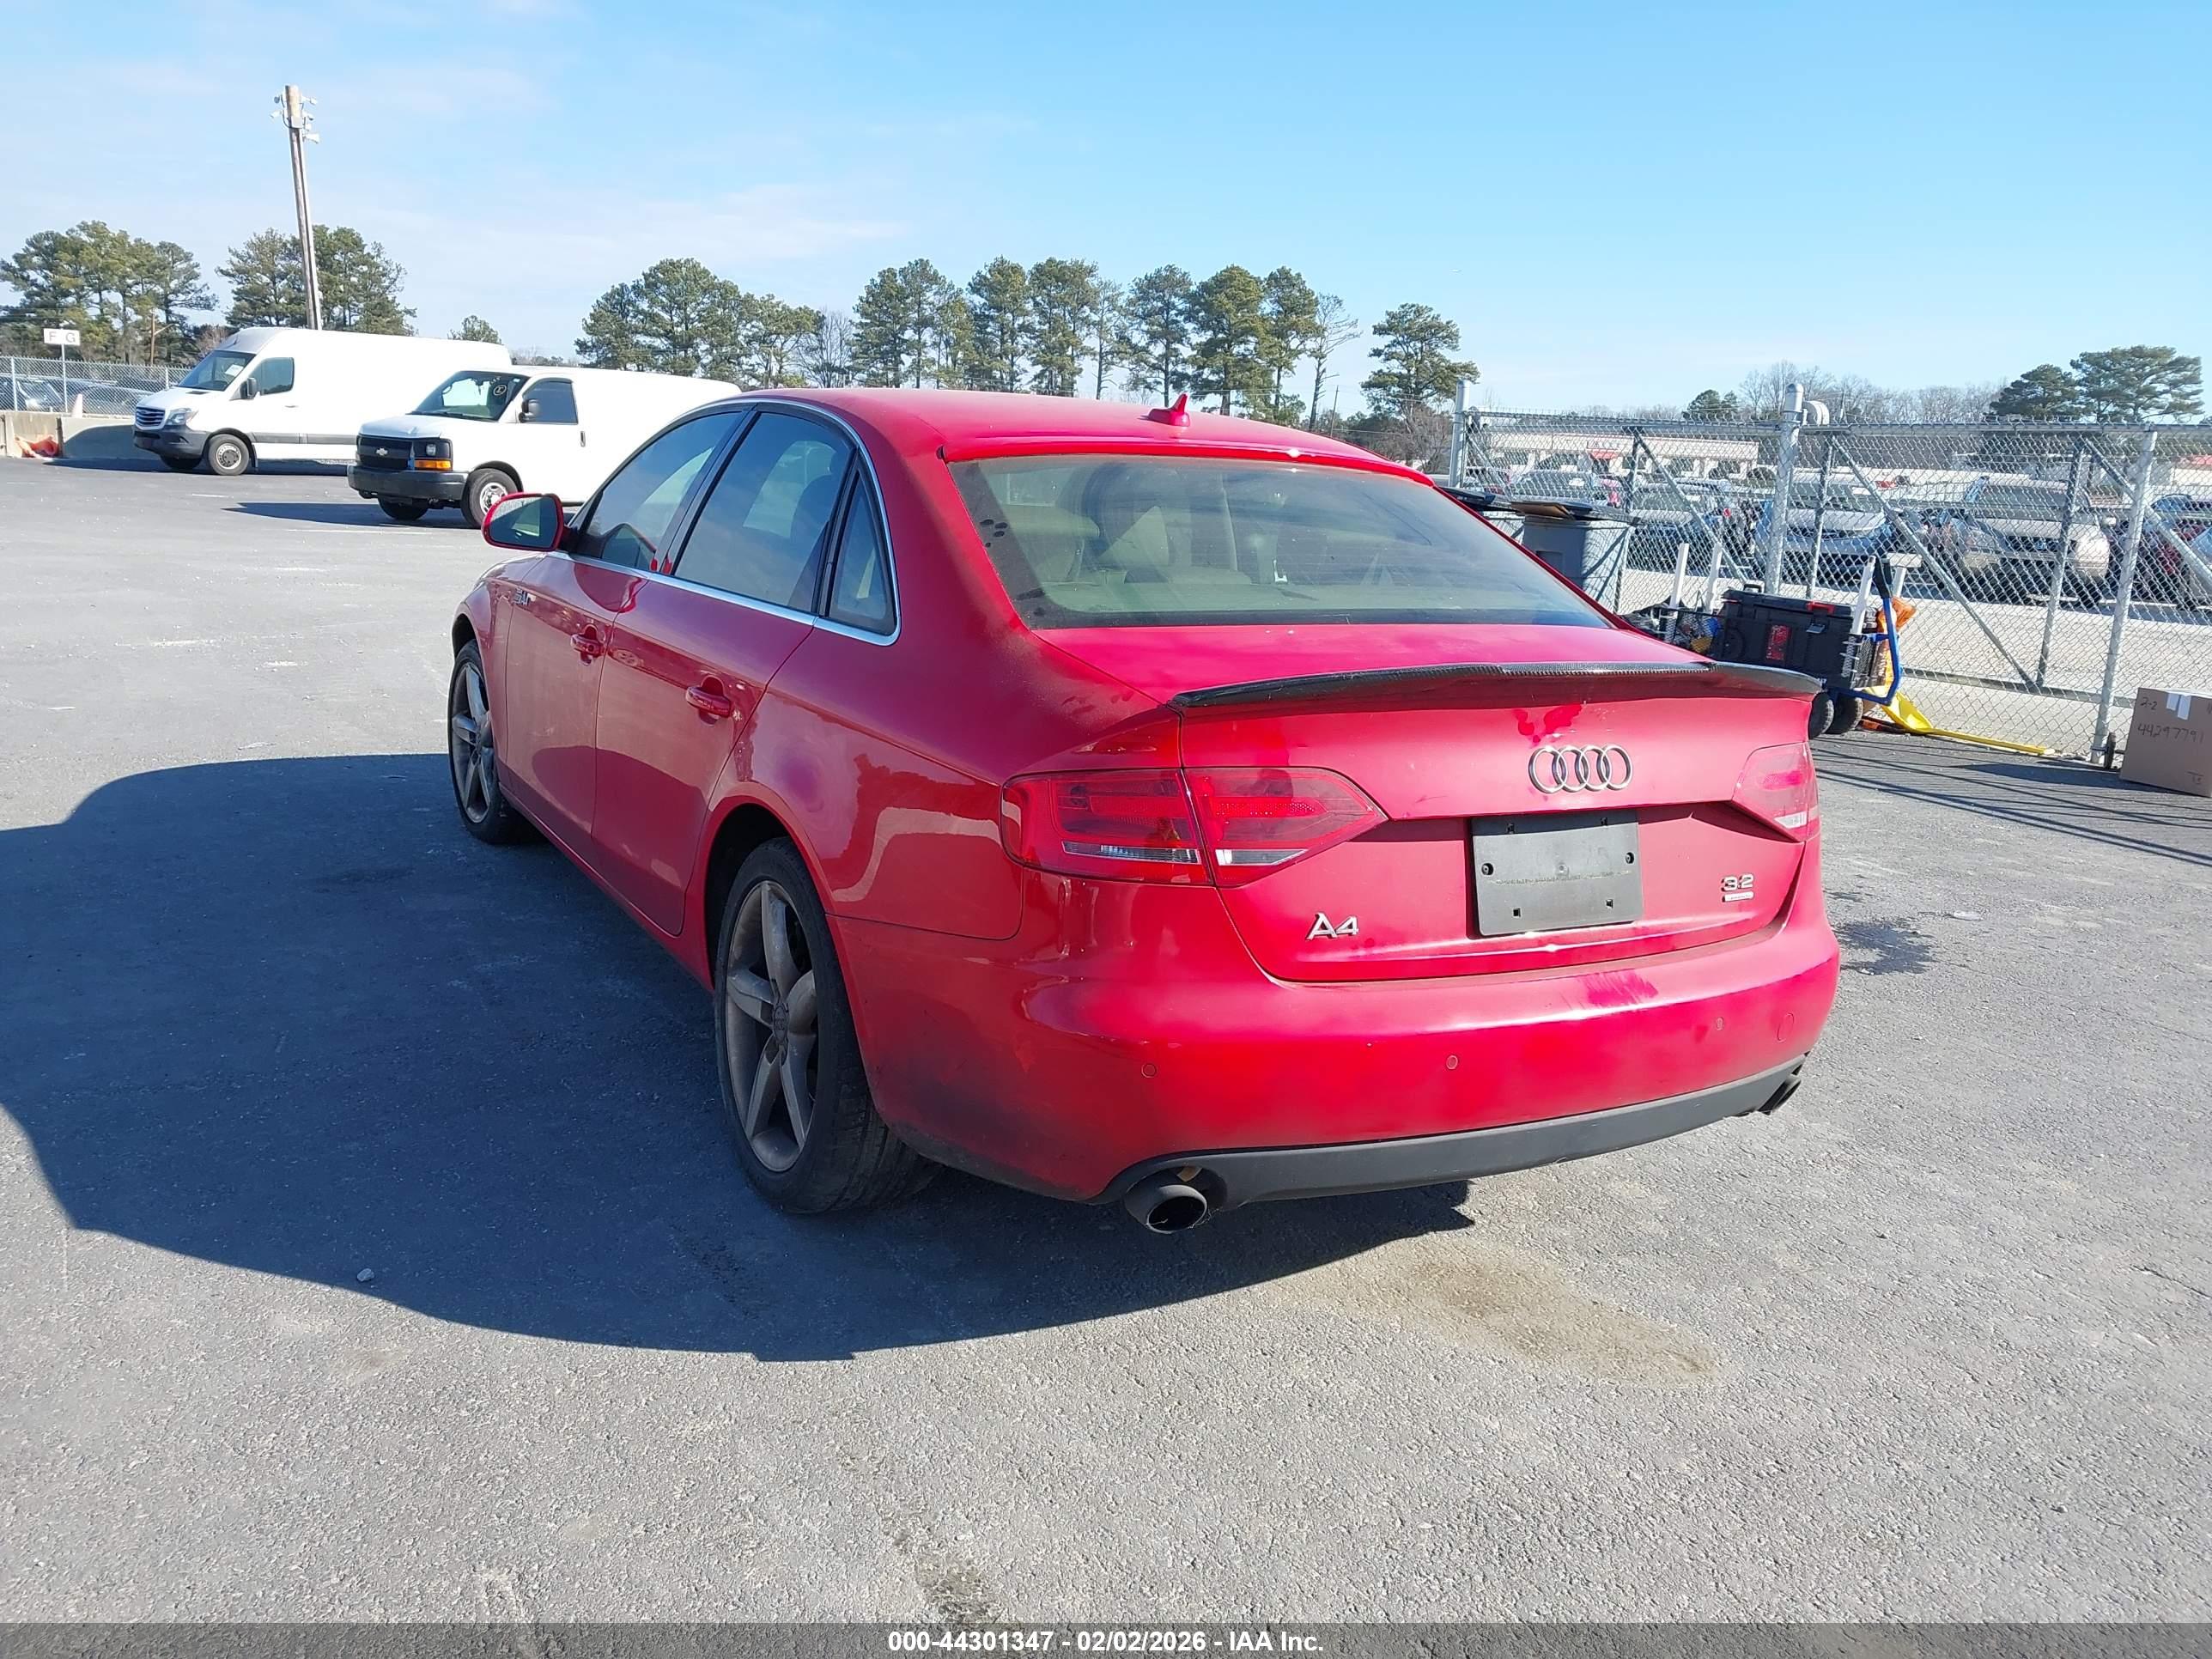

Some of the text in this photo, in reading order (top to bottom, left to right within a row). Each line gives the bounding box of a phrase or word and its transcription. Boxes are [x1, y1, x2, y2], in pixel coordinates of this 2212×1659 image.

[49, 331, 76, 343] F G
[1305, 912, 1359, 941] A4
